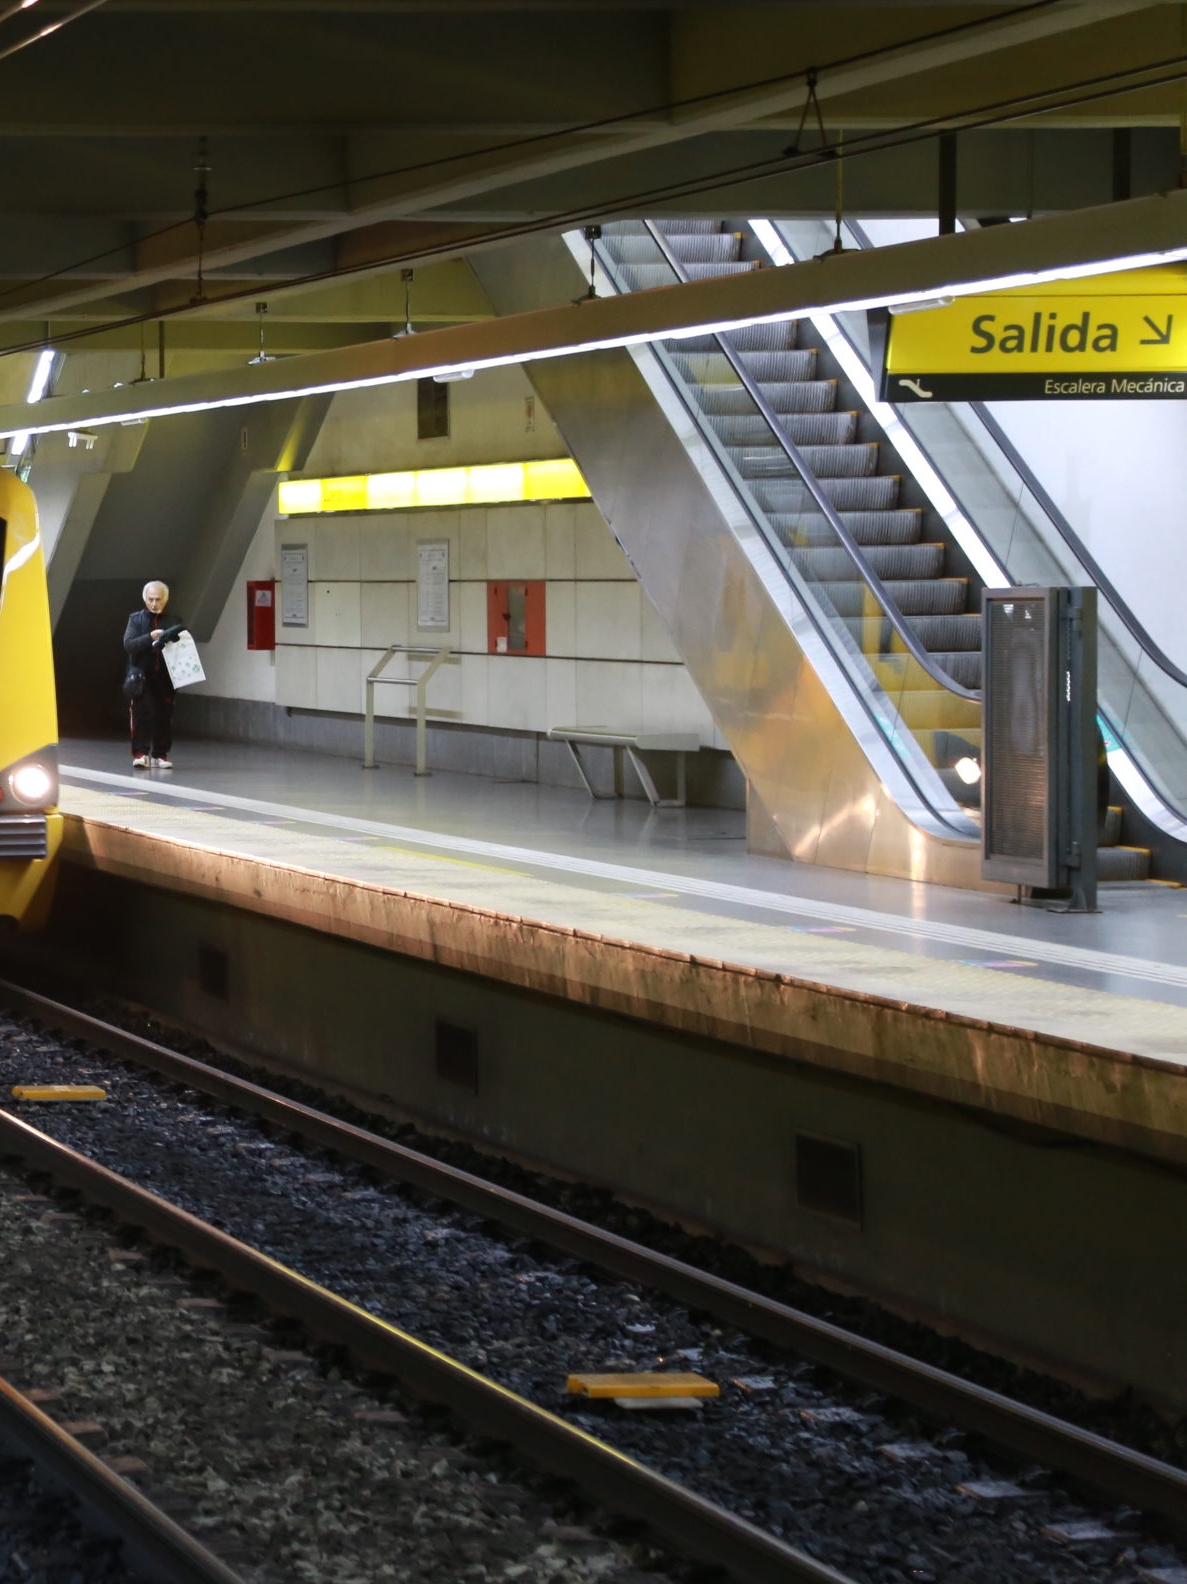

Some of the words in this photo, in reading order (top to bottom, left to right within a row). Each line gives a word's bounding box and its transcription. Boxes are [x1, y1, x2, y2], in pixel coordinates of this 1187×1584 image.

[970, 311, 1119, 355] Salida
[1044, 379, 1105, 394] Escalera
[1111, 378, 1185, 393] Mecánica
